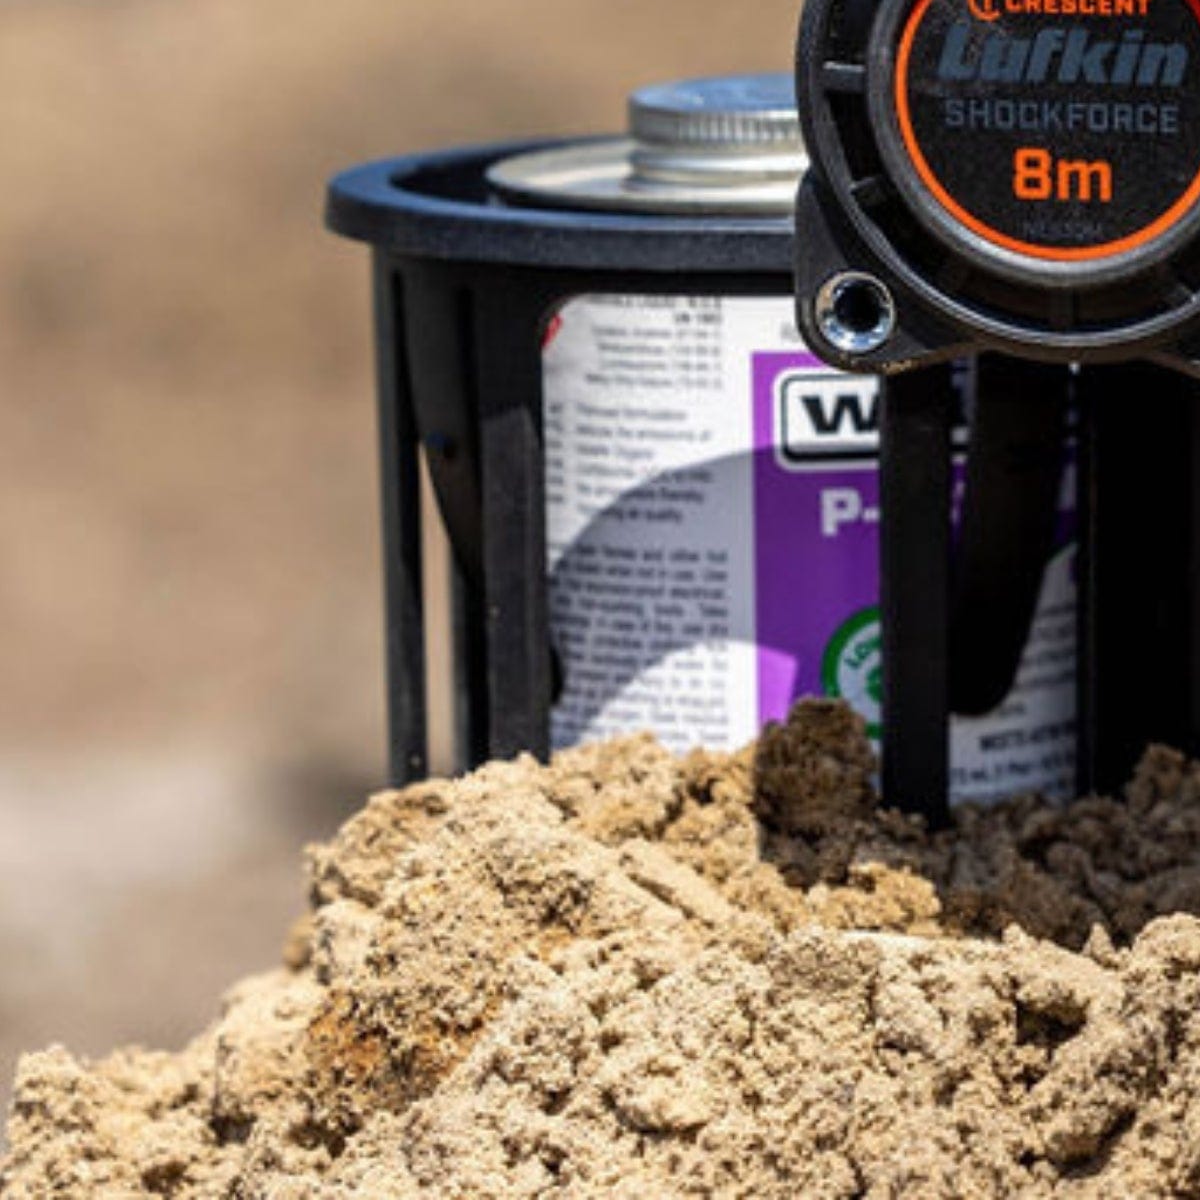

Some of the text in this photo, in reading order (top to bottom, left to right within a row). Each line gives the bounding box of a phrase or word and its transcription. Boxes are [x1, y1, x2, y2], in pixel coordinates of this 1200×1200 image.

[937, 22, 1190, 86] Lufkin
[945, 99, 1180, 133] SHOCKFORCE
[1012, 147, 1113, 202] 8m
